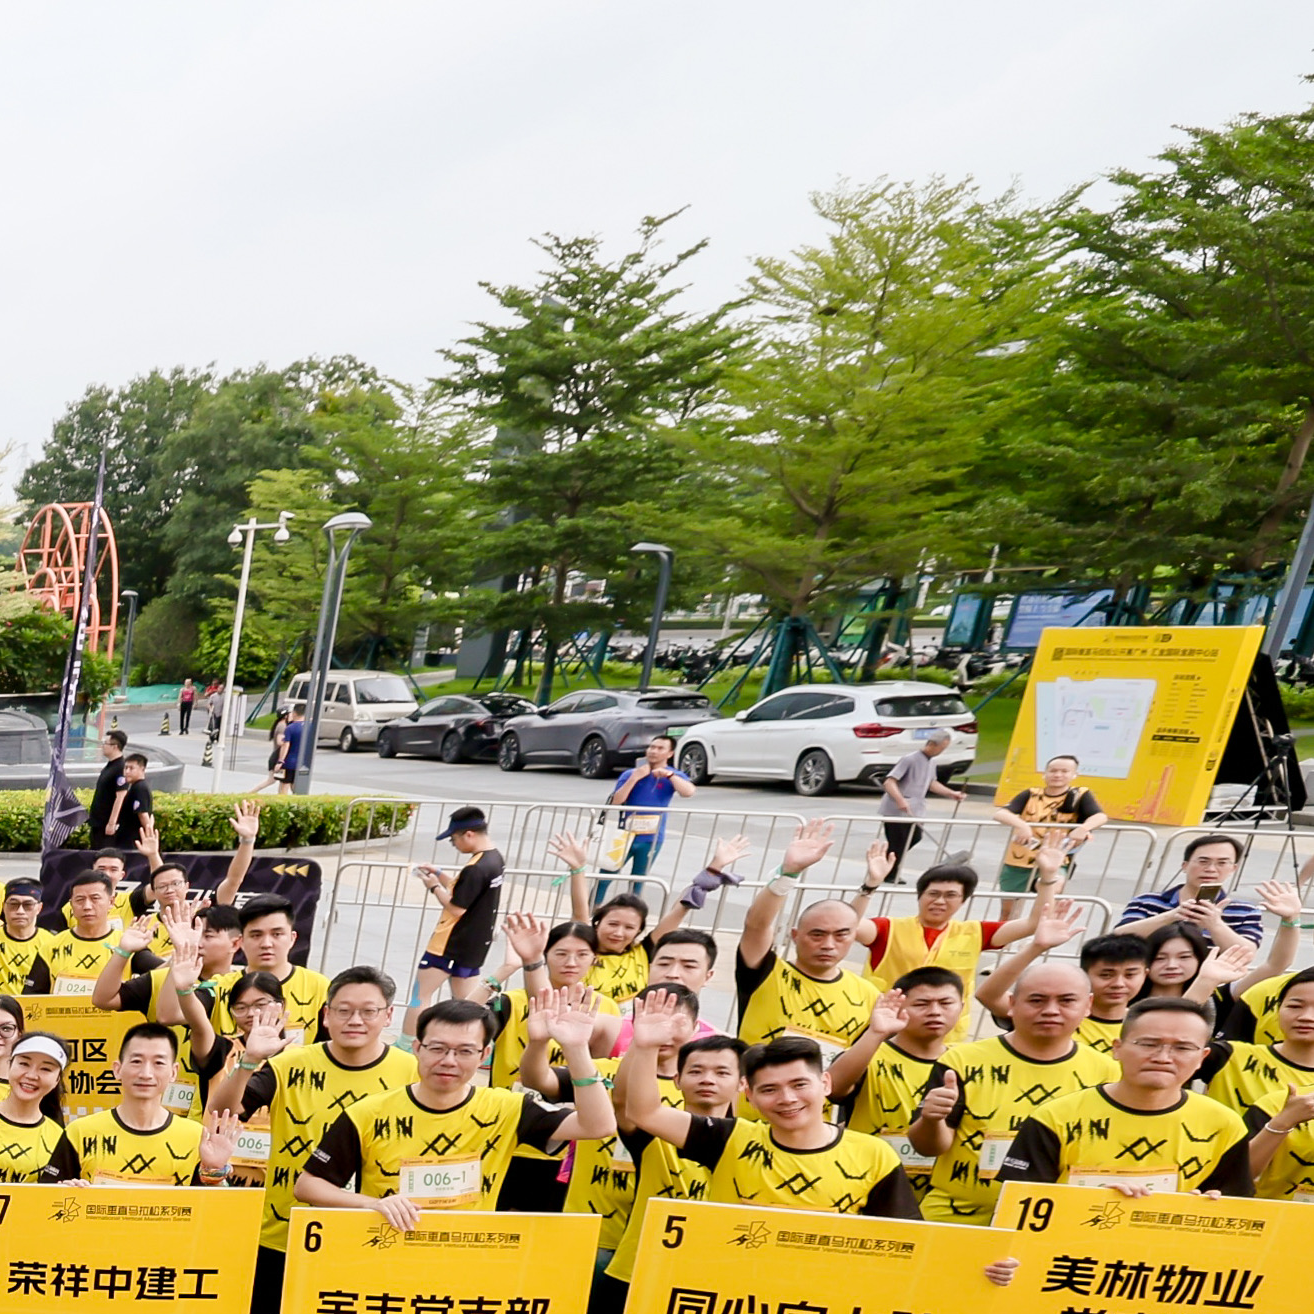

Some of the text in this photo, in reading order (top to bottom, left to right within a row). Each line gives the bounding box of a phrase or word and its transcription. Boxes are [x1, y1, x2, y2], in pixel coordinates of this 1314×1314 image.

[66, 983, 93, 993] 024-
[237, 1137, 271, 1149] 006-
[423, 1171, 467, 1186] 006-1
[86, 1205, 192, 1216] 国际垂直马拉松系列赛
[1017, 1197, 1055, 1232] 19
[1131, 1211, 1265, 1231] 国际垂直马拉松系列赛
[304, 1221, 323, 1253] 6
[404, 1231, 520, 1243] 国际垂直马拉松系列赛
[661, 1215, 687, 1250] 5
[777, 1231, 915, 1253] 国际垂直马拉松系列赛
[8, 1261, 219, 1300] 荣祥中建工
[1042, 1255, 1264, 1310] 美林物业
